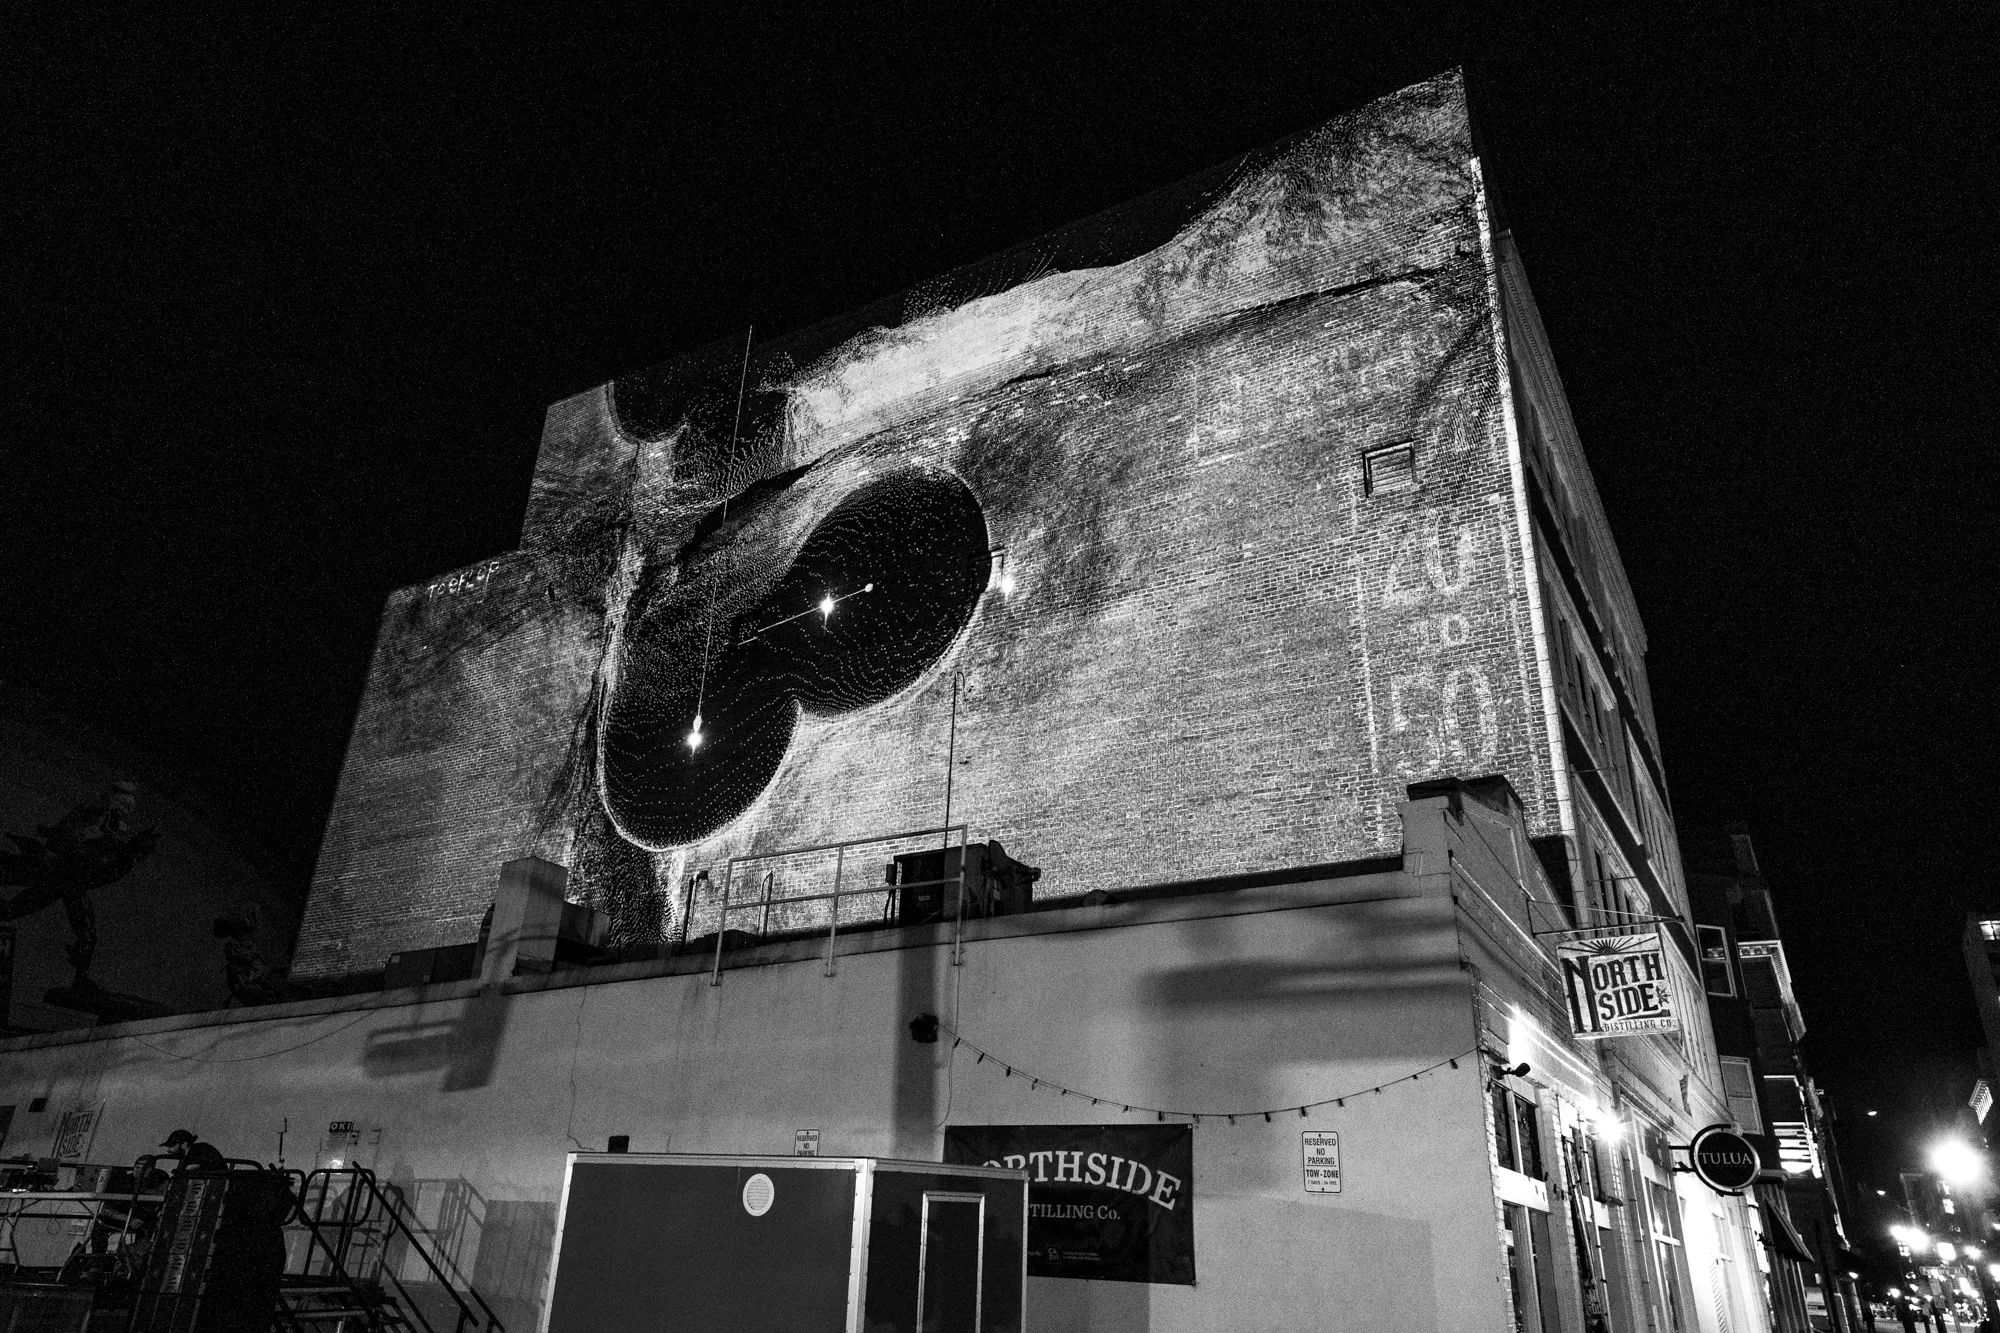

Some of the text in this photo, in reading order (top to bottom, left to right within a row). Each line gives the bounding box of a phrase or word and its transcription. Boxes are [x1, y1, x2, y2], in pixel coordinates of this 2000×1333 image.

[1559, 952, 1665, 1033] NORTH
[1597, 983, 1659, 1021] SIDE
[1604, 1020, 1656, 1032] DISTILLING
[1304, 1138, 1337, 1146] RESERVED
[1316, 1148, 1326, 1156] NO
[1698, 1152, 1753, 1165] TULUA
[1307, 1157, 1335, 1165] PARKING
[982, 1149, 1182, 1211] RTHSIDE
[1028, 1203, 1121, 1221] TILLING Co.
